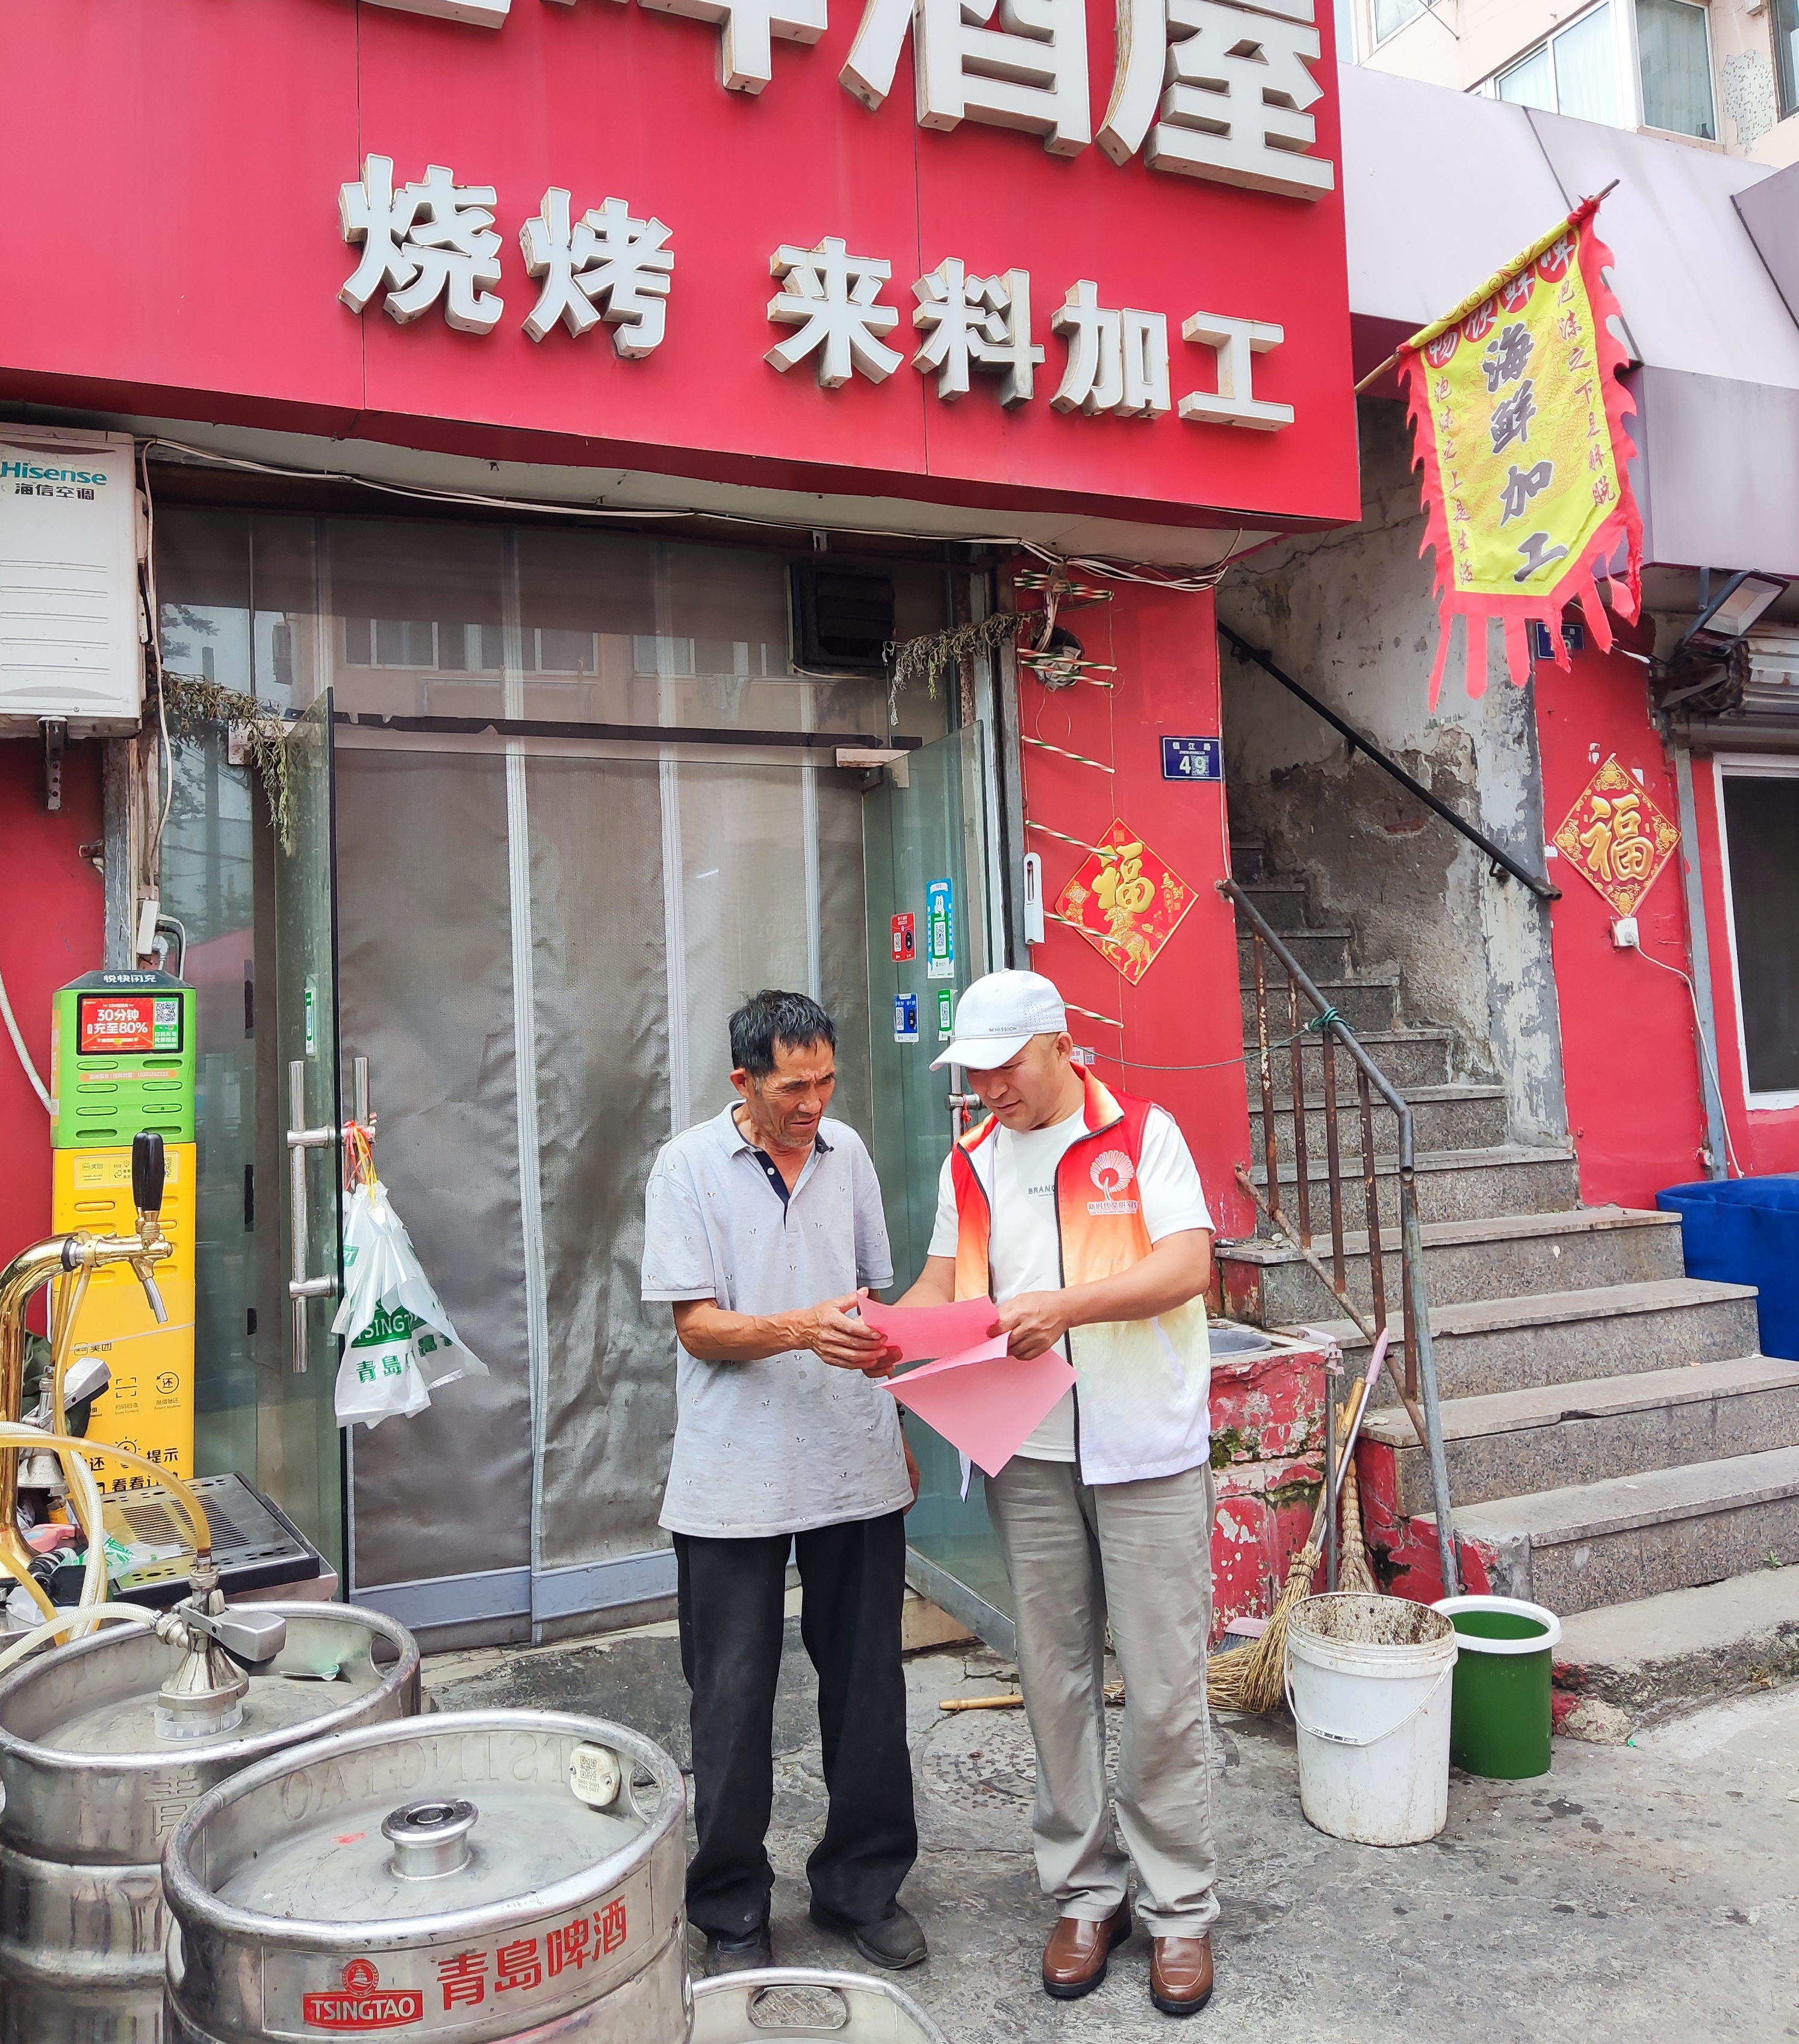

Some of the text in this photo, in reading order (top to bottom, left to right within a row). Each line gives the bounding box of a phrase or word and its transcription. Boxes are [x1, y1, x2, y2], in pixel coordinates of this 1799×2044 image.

[338, 153, 1294, 432] 烧烤 来料加工
[1558, 278, 1615, 507] 泡沫之下是解脱
[1482, 322, 1569, 582] 海鲜加工
[1, 461, 107, 486] Hisense
[1434, 376, 1474, 585] 泡沫之上是生活
[14, 483, 95, 500] 海信空调
[1579, 793, 1655, 882] 福
[1092, 842, 1155, 913] 福
[103, 974, 157, 983] 悦快闪充
[97, 1008, 139, 1022] 30分钟
[93, 1022, 148, 1034] 充至80%
[163, 1378, 173, 1388] 还
[146, 1447, 178, 1464] 提示
[310, 1996, 415, 2021] TSINGTAO
